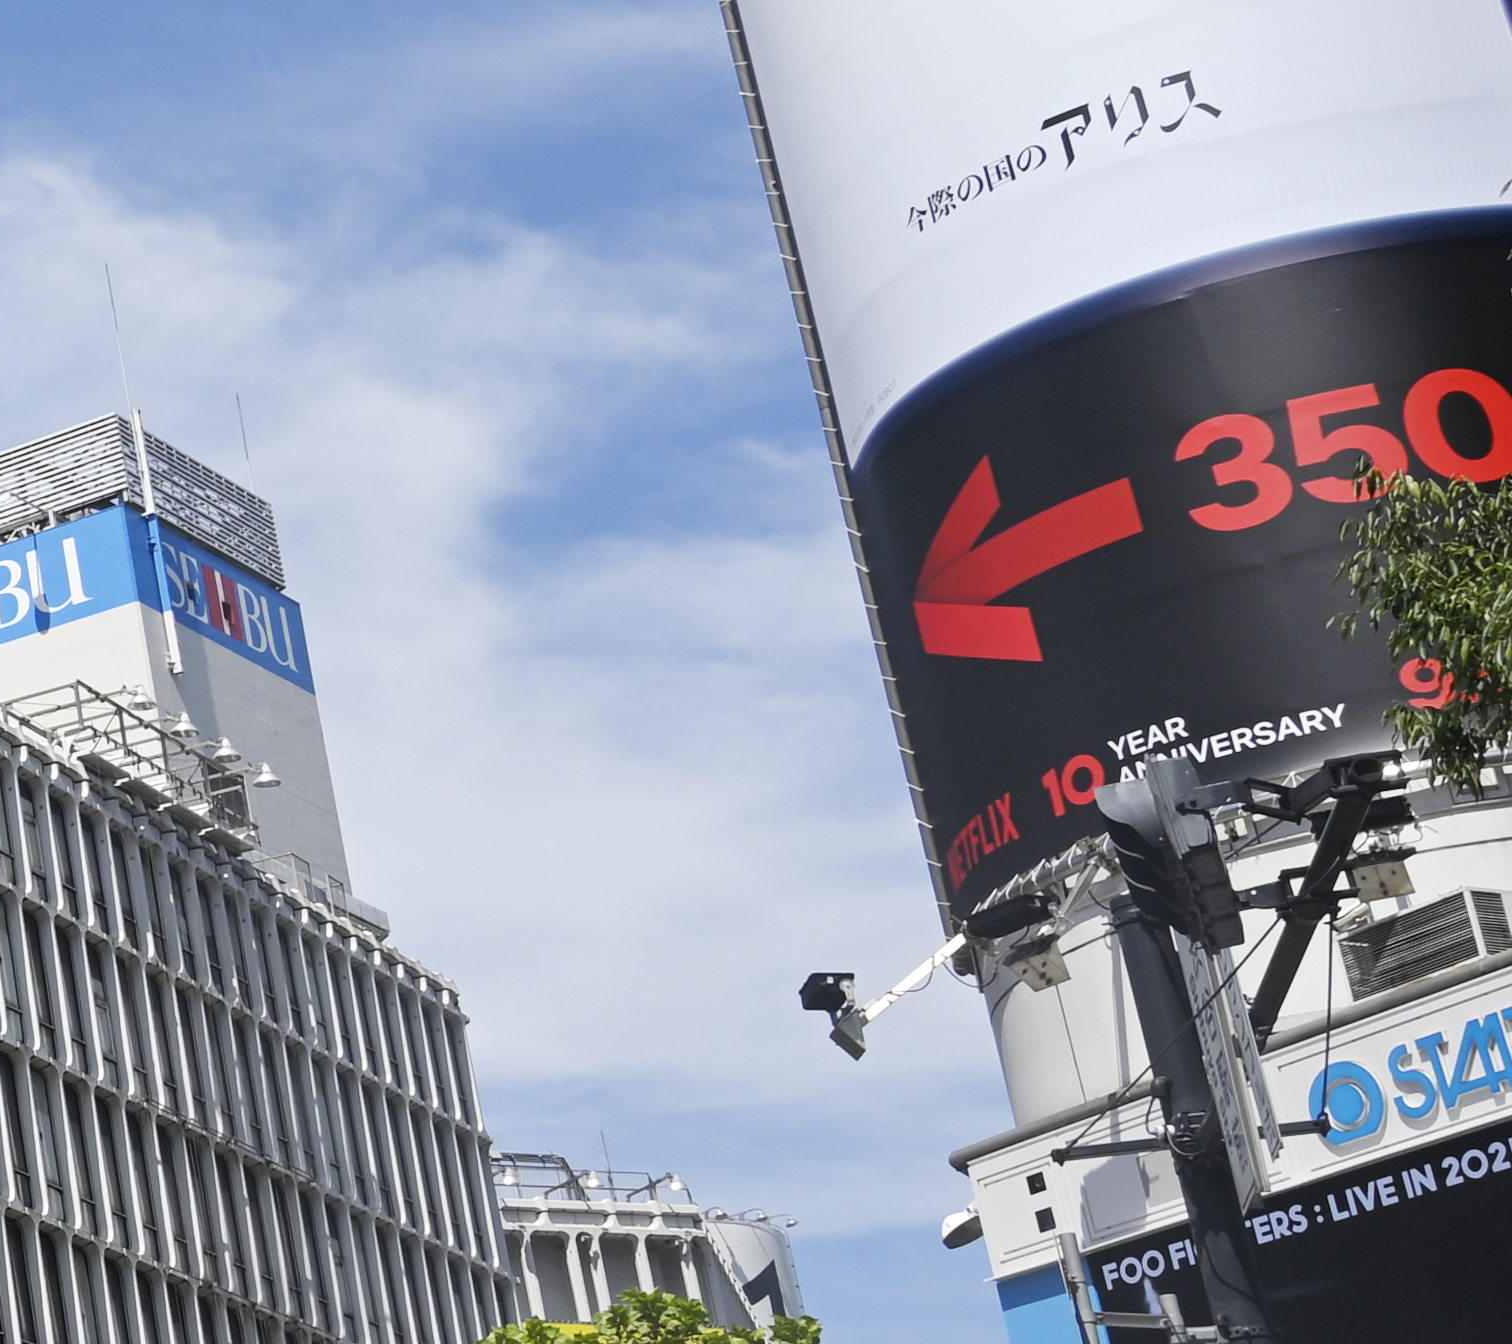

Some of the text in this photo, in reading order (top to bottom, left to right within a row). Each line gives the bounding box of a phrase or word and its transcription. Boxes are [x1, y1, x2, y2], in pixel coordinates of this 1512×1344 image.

[905, 67, 1223, 235] 今際の国のアリス
[1108, 715, 1190, 761] YEAR
[947, 754, 1105, 896] NETFLIX 10
[1102, 1250, 1166, 1290] FOO
[1167, 1202, 1308, 1270] FIERS
[1325, 1174, 1400, 1222] LIVE
[1402, 1162, 1437, 1200] IN
